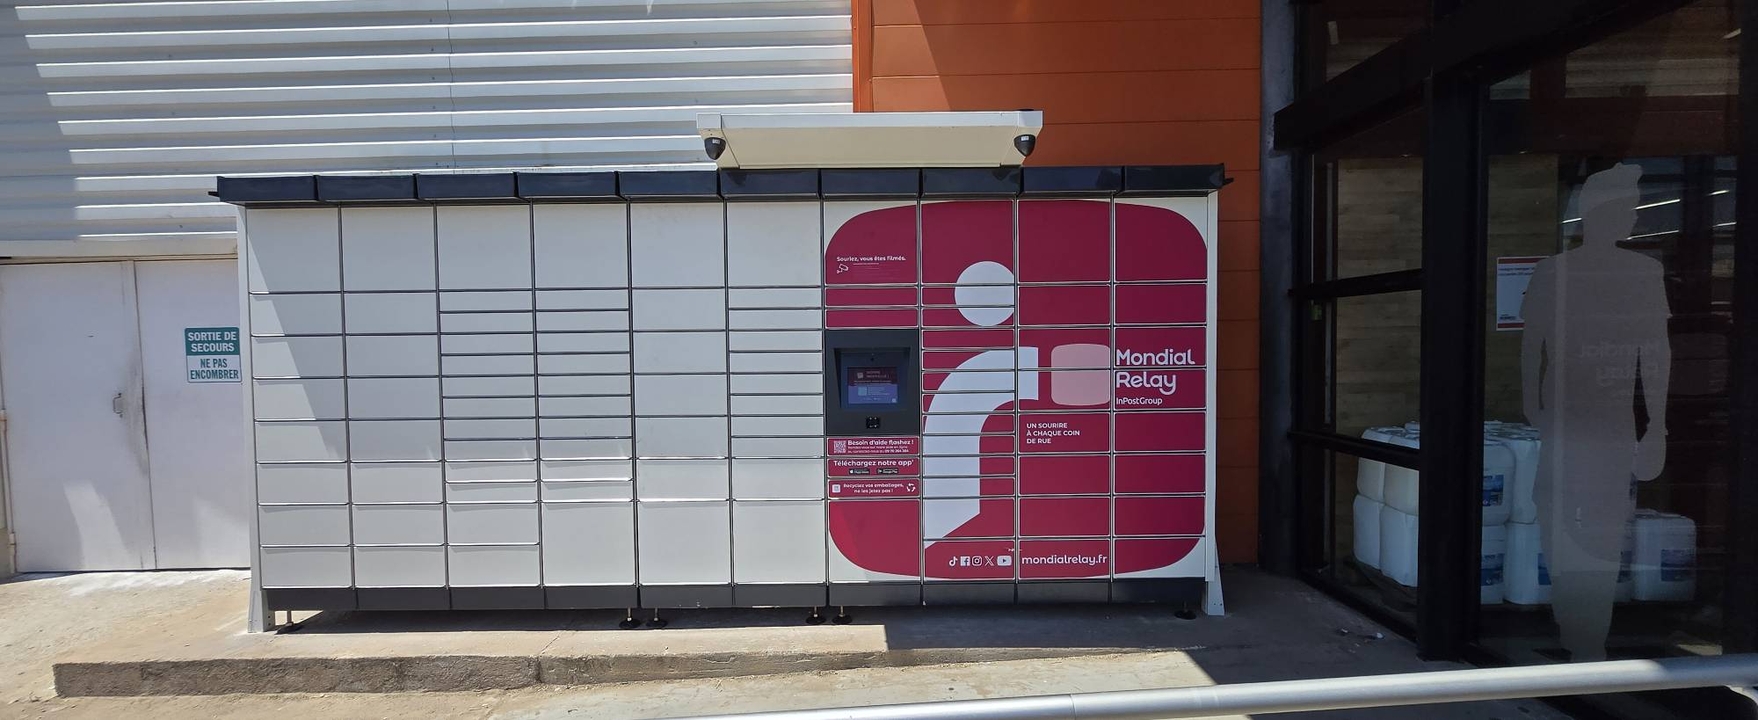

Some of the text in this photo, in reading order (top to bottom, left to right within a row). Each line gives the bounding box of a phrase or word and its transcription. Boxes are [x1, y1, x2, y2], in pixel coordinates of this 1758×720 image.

[188, 331, 237, 341] SORTIE DE
[191, 342, 235, 352] SECOURS
[1116, 348, 1196, 366] Mondial
[200, 358, 228, 368] NE PAS
[190, 369, 239, 380] ENCOMBRER
[1116, 371, 1177, 396] Relay
[1021, 554, 1108, 566] mondialrelay.fr
